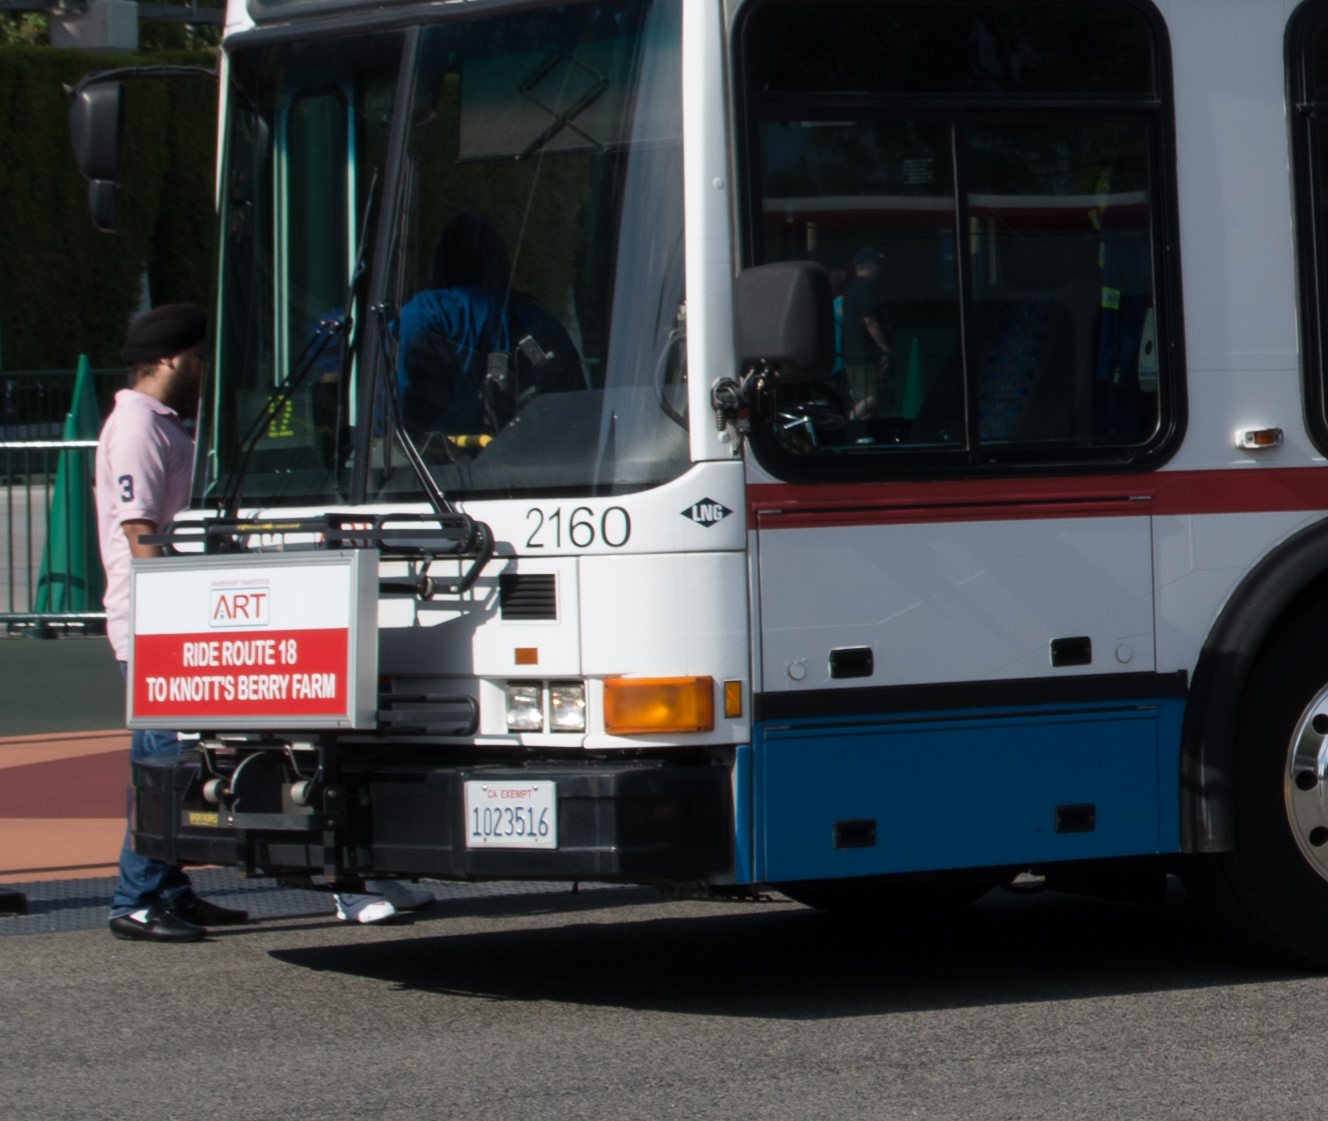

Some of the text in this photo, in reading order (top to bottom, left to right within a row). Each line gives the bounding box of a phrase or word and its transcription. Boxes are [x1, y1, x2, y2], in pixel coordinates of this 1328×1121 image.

[118, 474, 135, 503] 3
[525, 505, 632, 549] 2160
[692, 504, 723, 522] LNG
[213, 593, 267, 620] ART
[183, 638, 298, 667] RIDE ROUTE 18
[146, 672, 336, 702] TO KNOTT'S BERRY FARM
[487, 790, 533, 799] CA EXEMPT
[472, 806, 549, 837] 1023516
